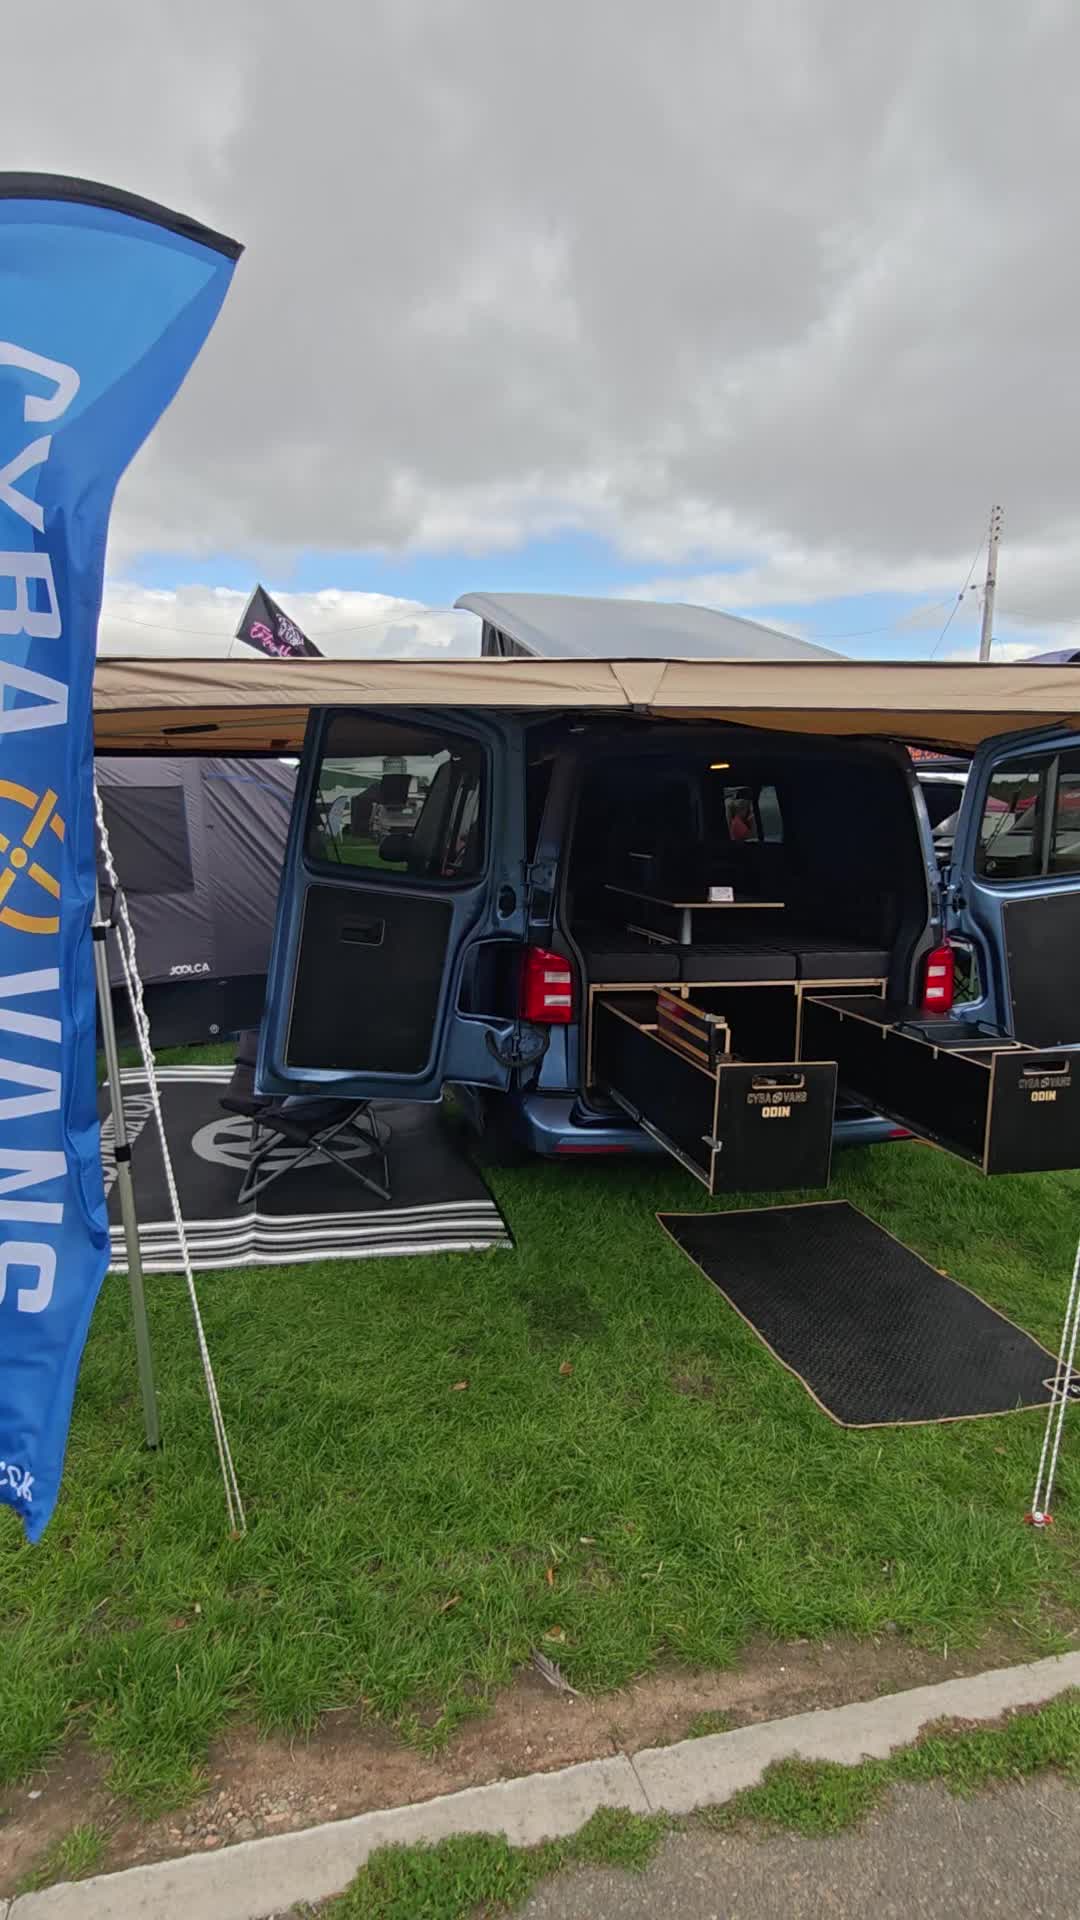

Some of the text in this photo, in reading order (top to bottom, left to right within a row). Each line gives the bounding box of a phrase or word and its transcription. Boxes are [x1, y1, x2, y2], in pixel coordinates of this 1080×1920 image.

[169, 963, 211, 976] JOOLCA
[1031, 1090, 1057, 1102] ODIN
[761, 1106, 791, 1118] ODIN
[0, 967, 67, 1313] VANS
